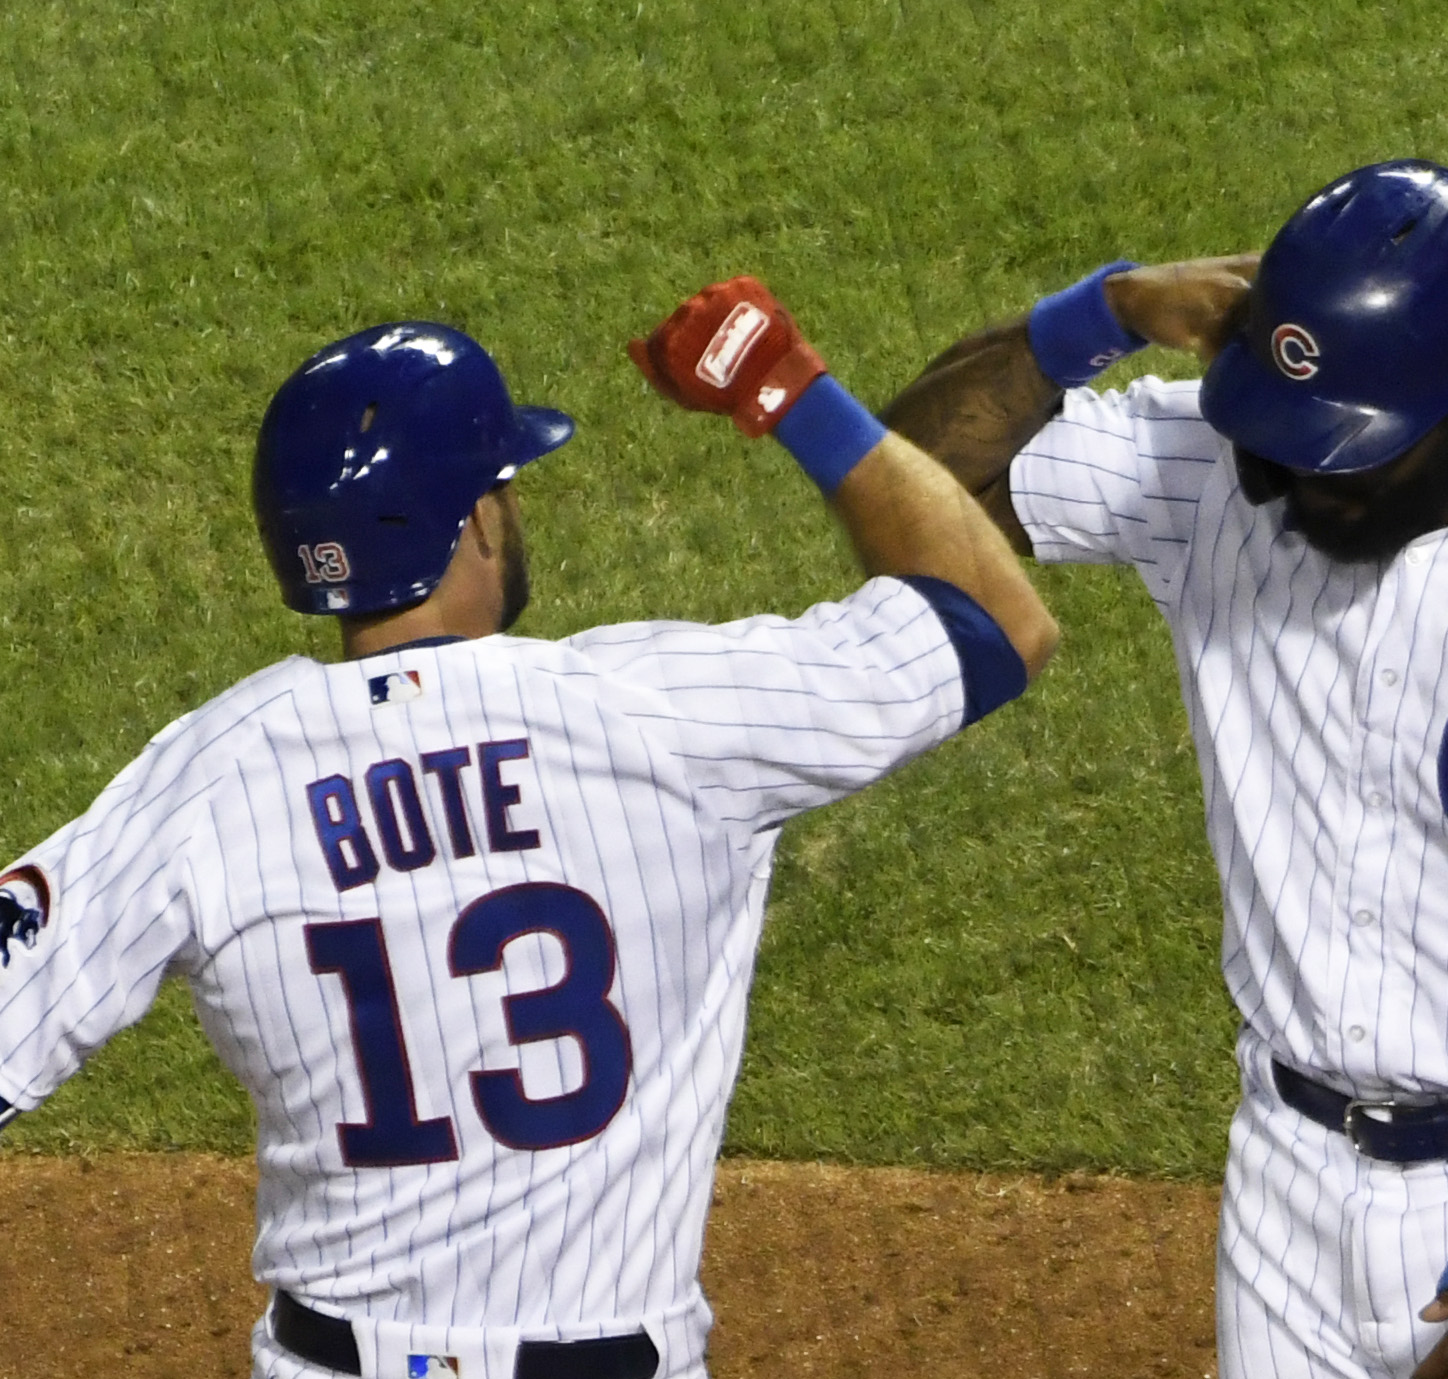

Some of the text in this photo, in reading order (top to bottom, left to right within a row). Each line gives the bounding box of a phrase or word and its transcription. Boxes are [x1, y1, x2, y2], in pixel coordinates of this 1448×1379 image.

[1271, 323, 1320, 381] C
[297, 542, 351, 584] 13
[306, 738, 540, 892] BOTE
[304, 881, 633, 1168] 13
